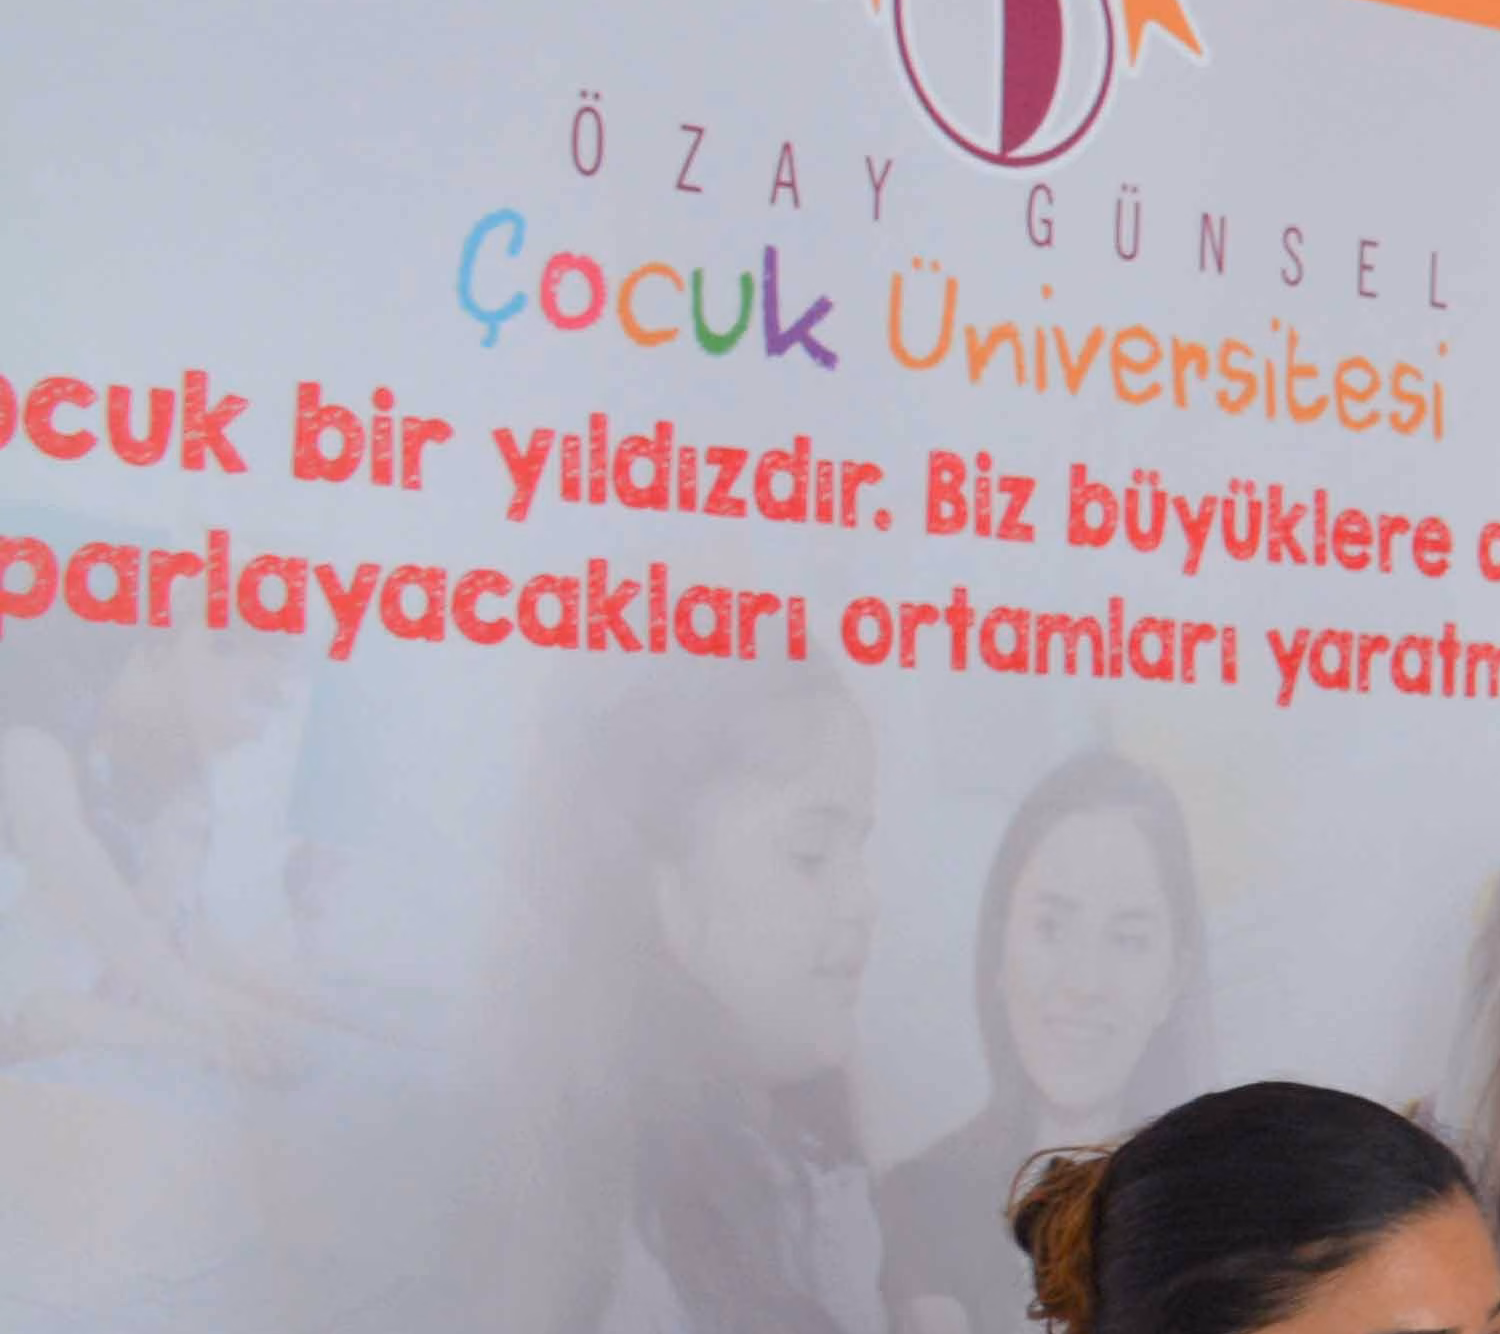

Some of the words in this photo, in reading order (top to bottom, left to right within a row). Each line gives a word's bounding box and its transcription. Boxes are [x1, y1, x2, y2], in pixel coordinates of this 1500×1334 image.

[570, 88, 894, 224] ÖZAY
[1025, 180, 1449, 312] GÜNSEL
[456, 207, 840, 372] Çocuk
[886, 257, 1447, 442] Üniversitesi
[0, 369, 249, 475] cuk
[293, 381, 454, 491] bir
[492, 411, 895, 533] yıldızdır.
[926, 449, 1037, 543] Biz
[1066, 461, 1454, 579] büyüklere
[841, 585, 1238, 685] ortamları
